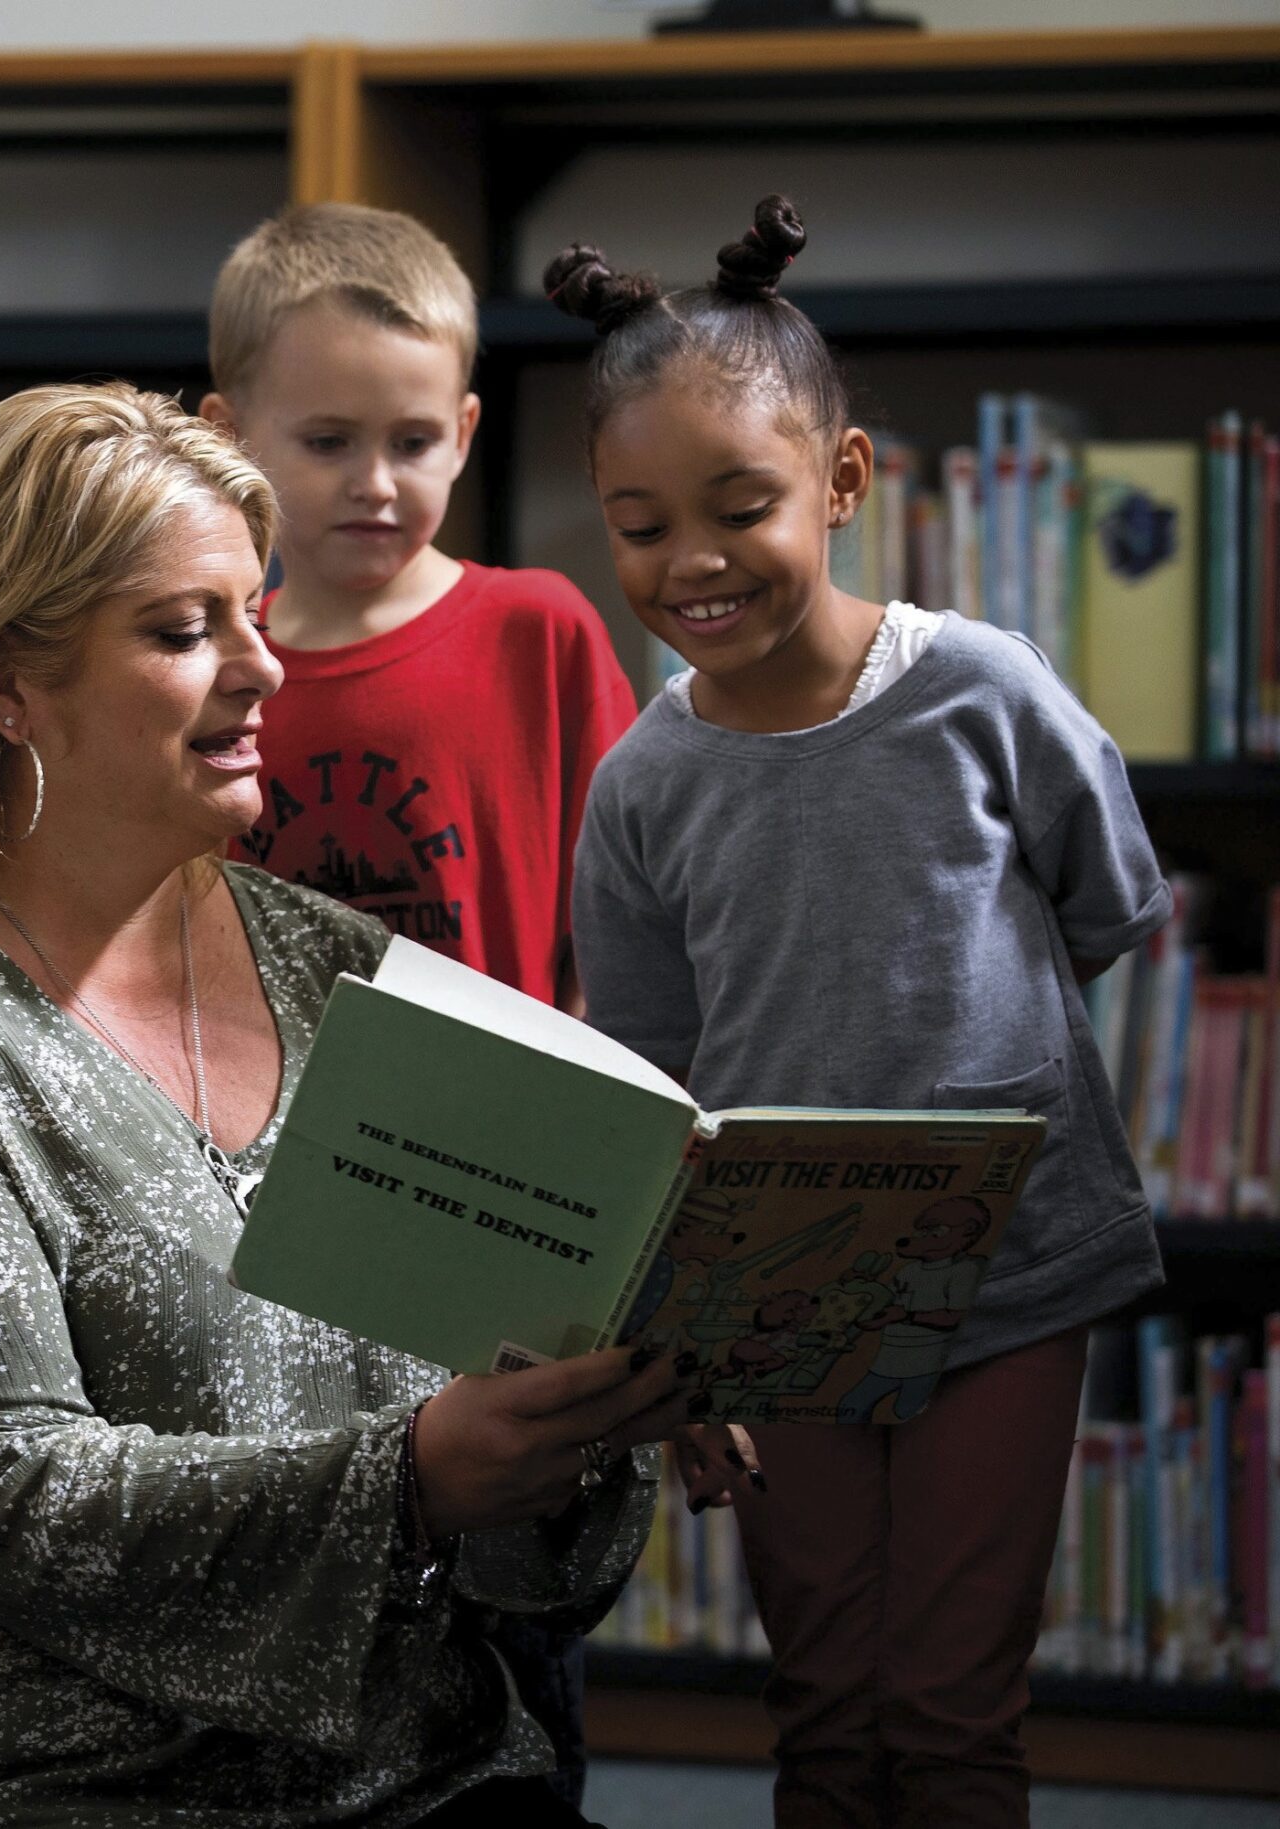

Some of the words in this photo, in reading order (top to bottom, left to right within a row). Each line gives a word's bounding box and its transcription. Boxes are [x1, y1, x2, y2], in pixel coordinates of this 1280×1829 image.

[241, 751, 465, 872] EATTLE
[332, 1154, 405, 1194] VISIT
[413, 1185, 468, 1219] THE
[473, 1209, 595, 1266] DENTIST
[357, 1121, 397, 1146] THE
[400, 1137, 528, 1194] BERENSTAIN
[532, 1186, 599, 1219] BEARS
[704, 1160, 779, 1188] VISIT
[780, 1161, 834, 1189] THE
[839, 1162, 962, 1191] DENTIST
[754, 1401, 857, 1418] Berenstain
